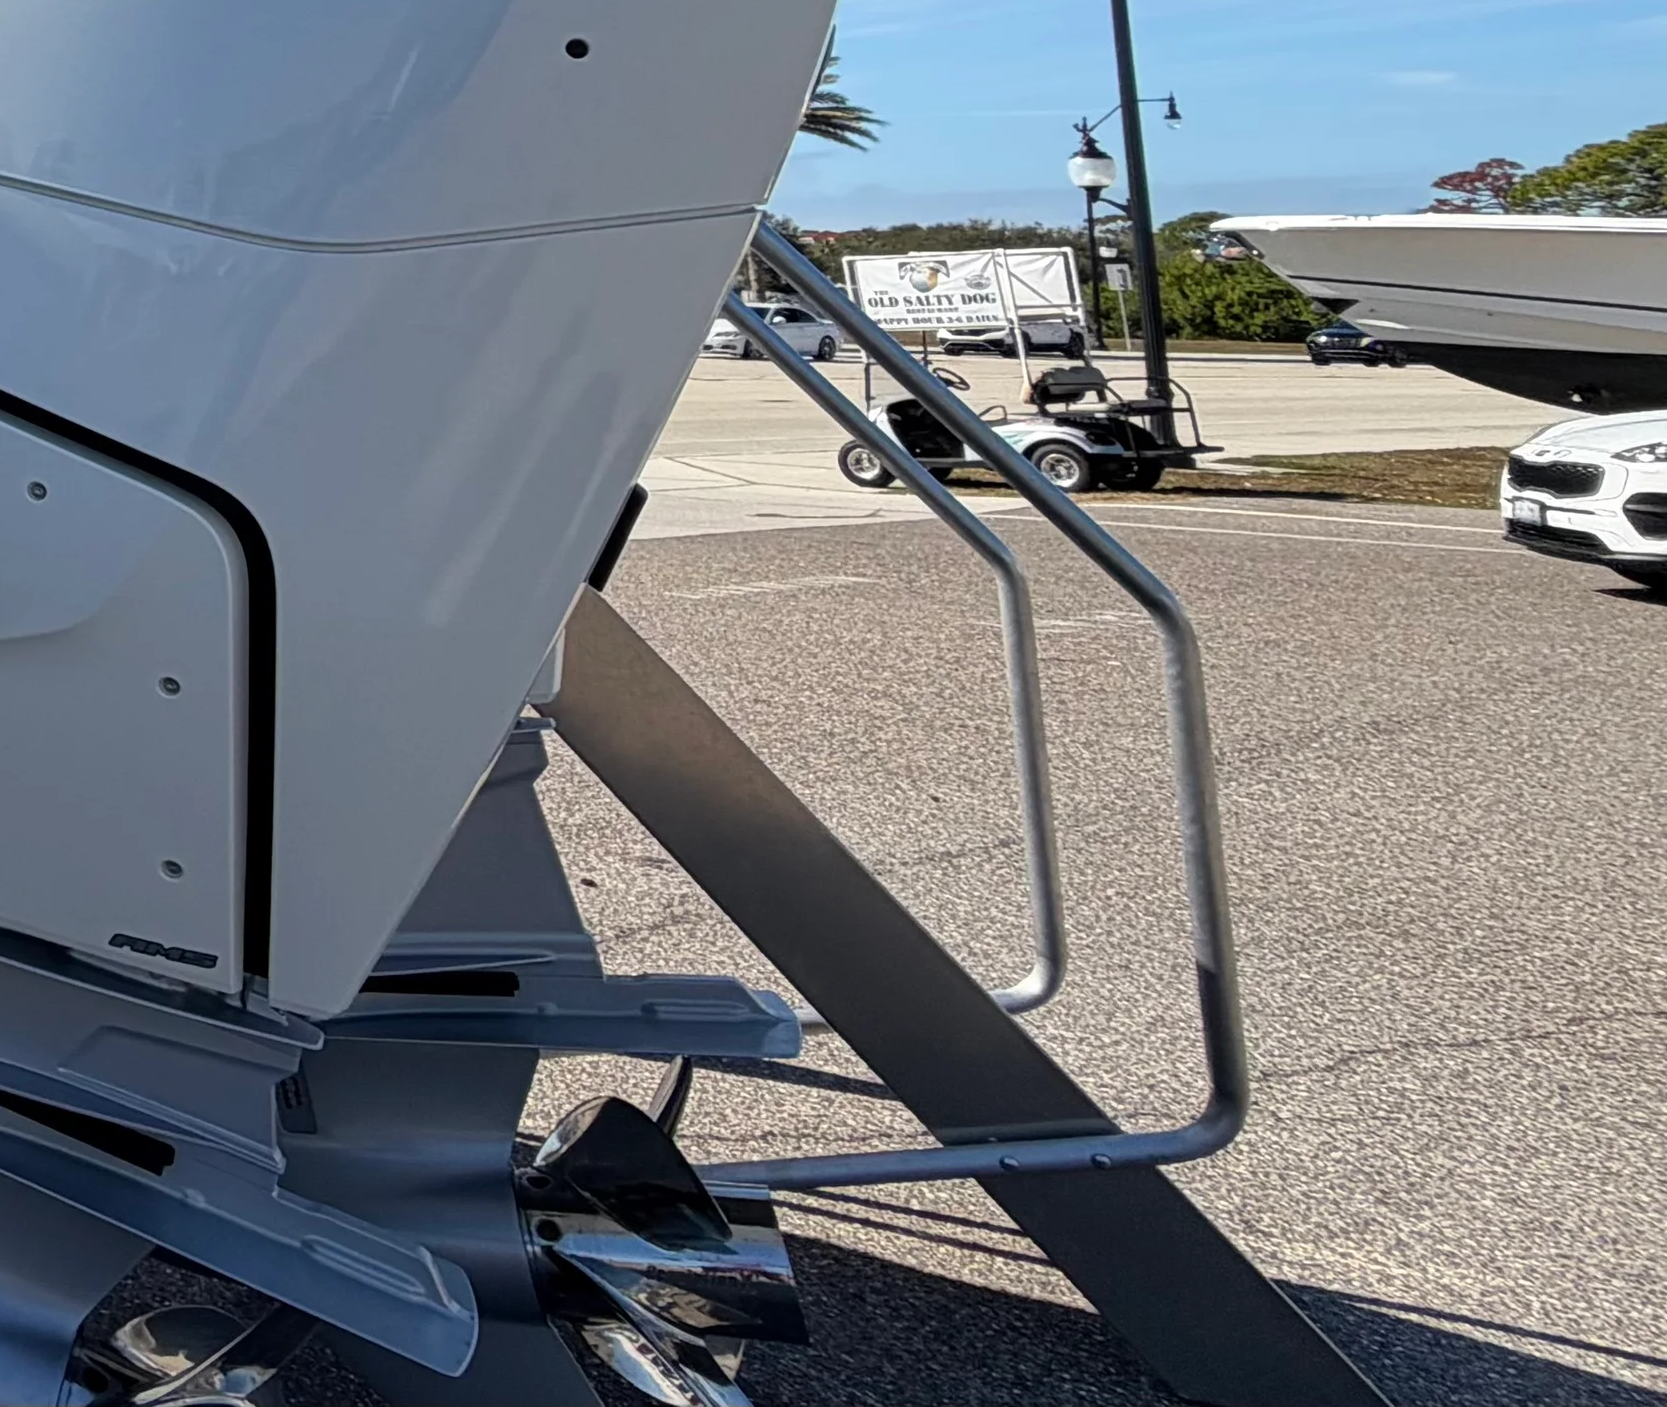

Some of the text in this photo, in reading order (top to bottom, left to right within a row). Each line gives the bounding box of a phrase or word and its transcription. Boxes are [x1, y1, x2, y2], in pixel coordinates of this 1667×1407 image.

[867, 292, 997, 308] OLD SALTY DOG
[912, 316, 945, 324] HOUR
